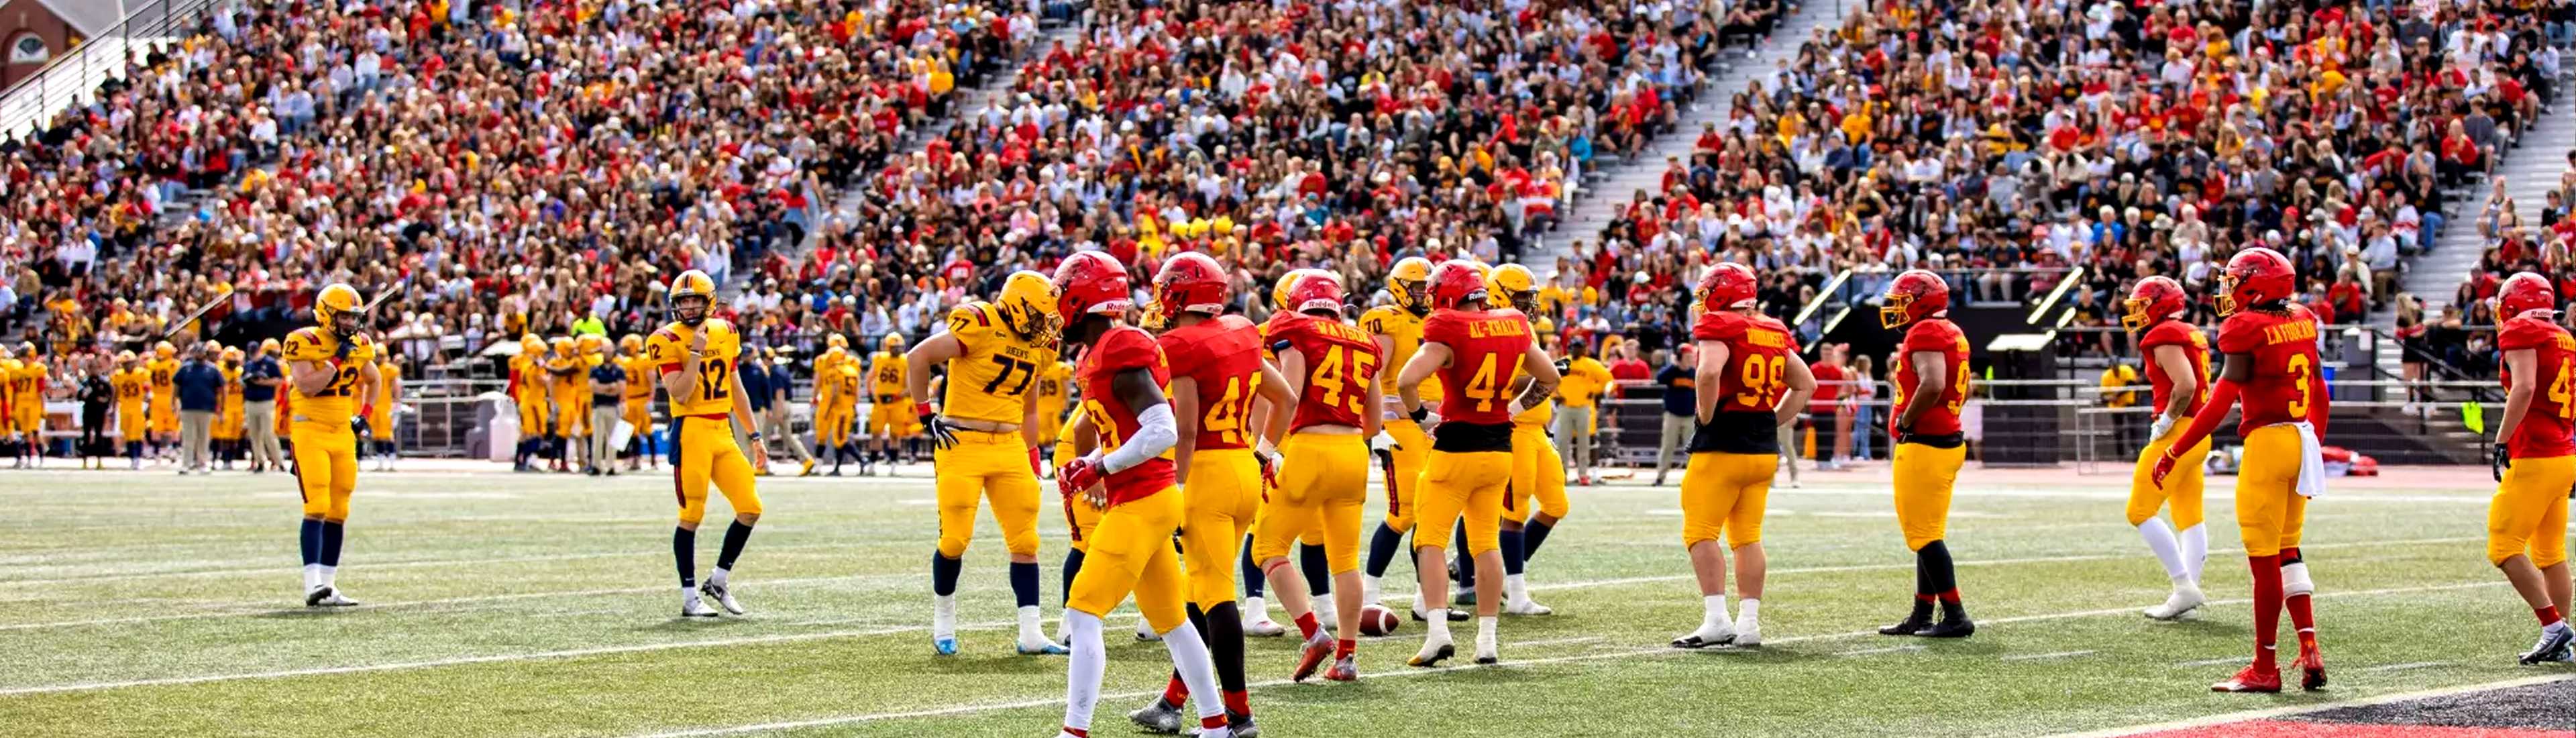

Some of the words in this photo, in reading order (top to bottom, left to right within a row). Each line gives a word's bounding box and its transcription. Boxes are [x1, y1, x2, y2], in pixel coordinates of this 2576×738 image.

[1315, 321, 1371, 344] WATSON
[1365, 318, 1381, 334] 70
[284, 341, 299, 356] 22
[647, 344, 661, 360] 12
[699, 358, 728, 401] 12
[879, 368, 899, 383] 66
[982, 354, 1036, 396] 77
[1311, 345, 1376, 415] 45
[2288, 354, 2310, 419] 3
